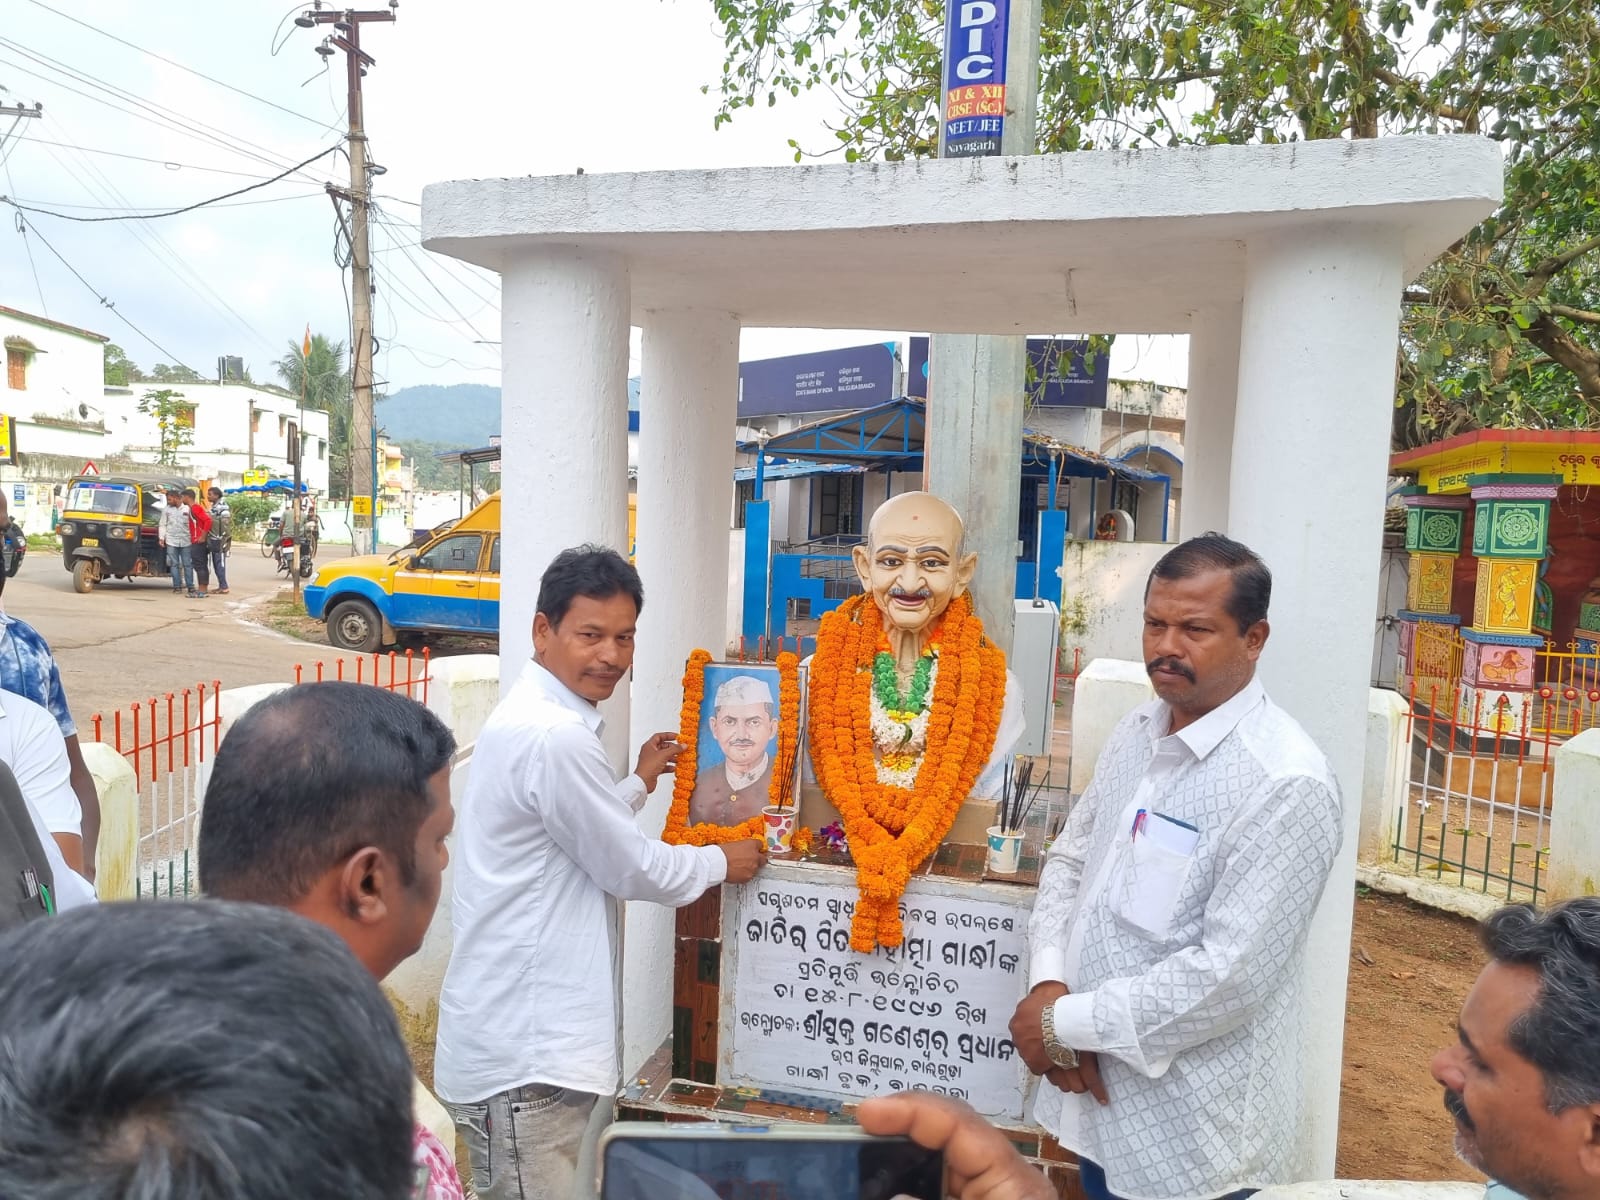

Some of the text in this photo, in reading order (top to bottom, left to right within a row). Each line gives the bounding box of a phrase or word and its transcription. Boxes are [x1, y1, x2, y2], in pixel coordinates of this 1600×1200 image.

[957, 0, 996, 80] DIC
[965, 88, 976, 99] &
[981, 86, 1002, 99] XII
[948, 119, 1000, 136] NEET/JEE
[816, 920, 850, 952] ପିତ
